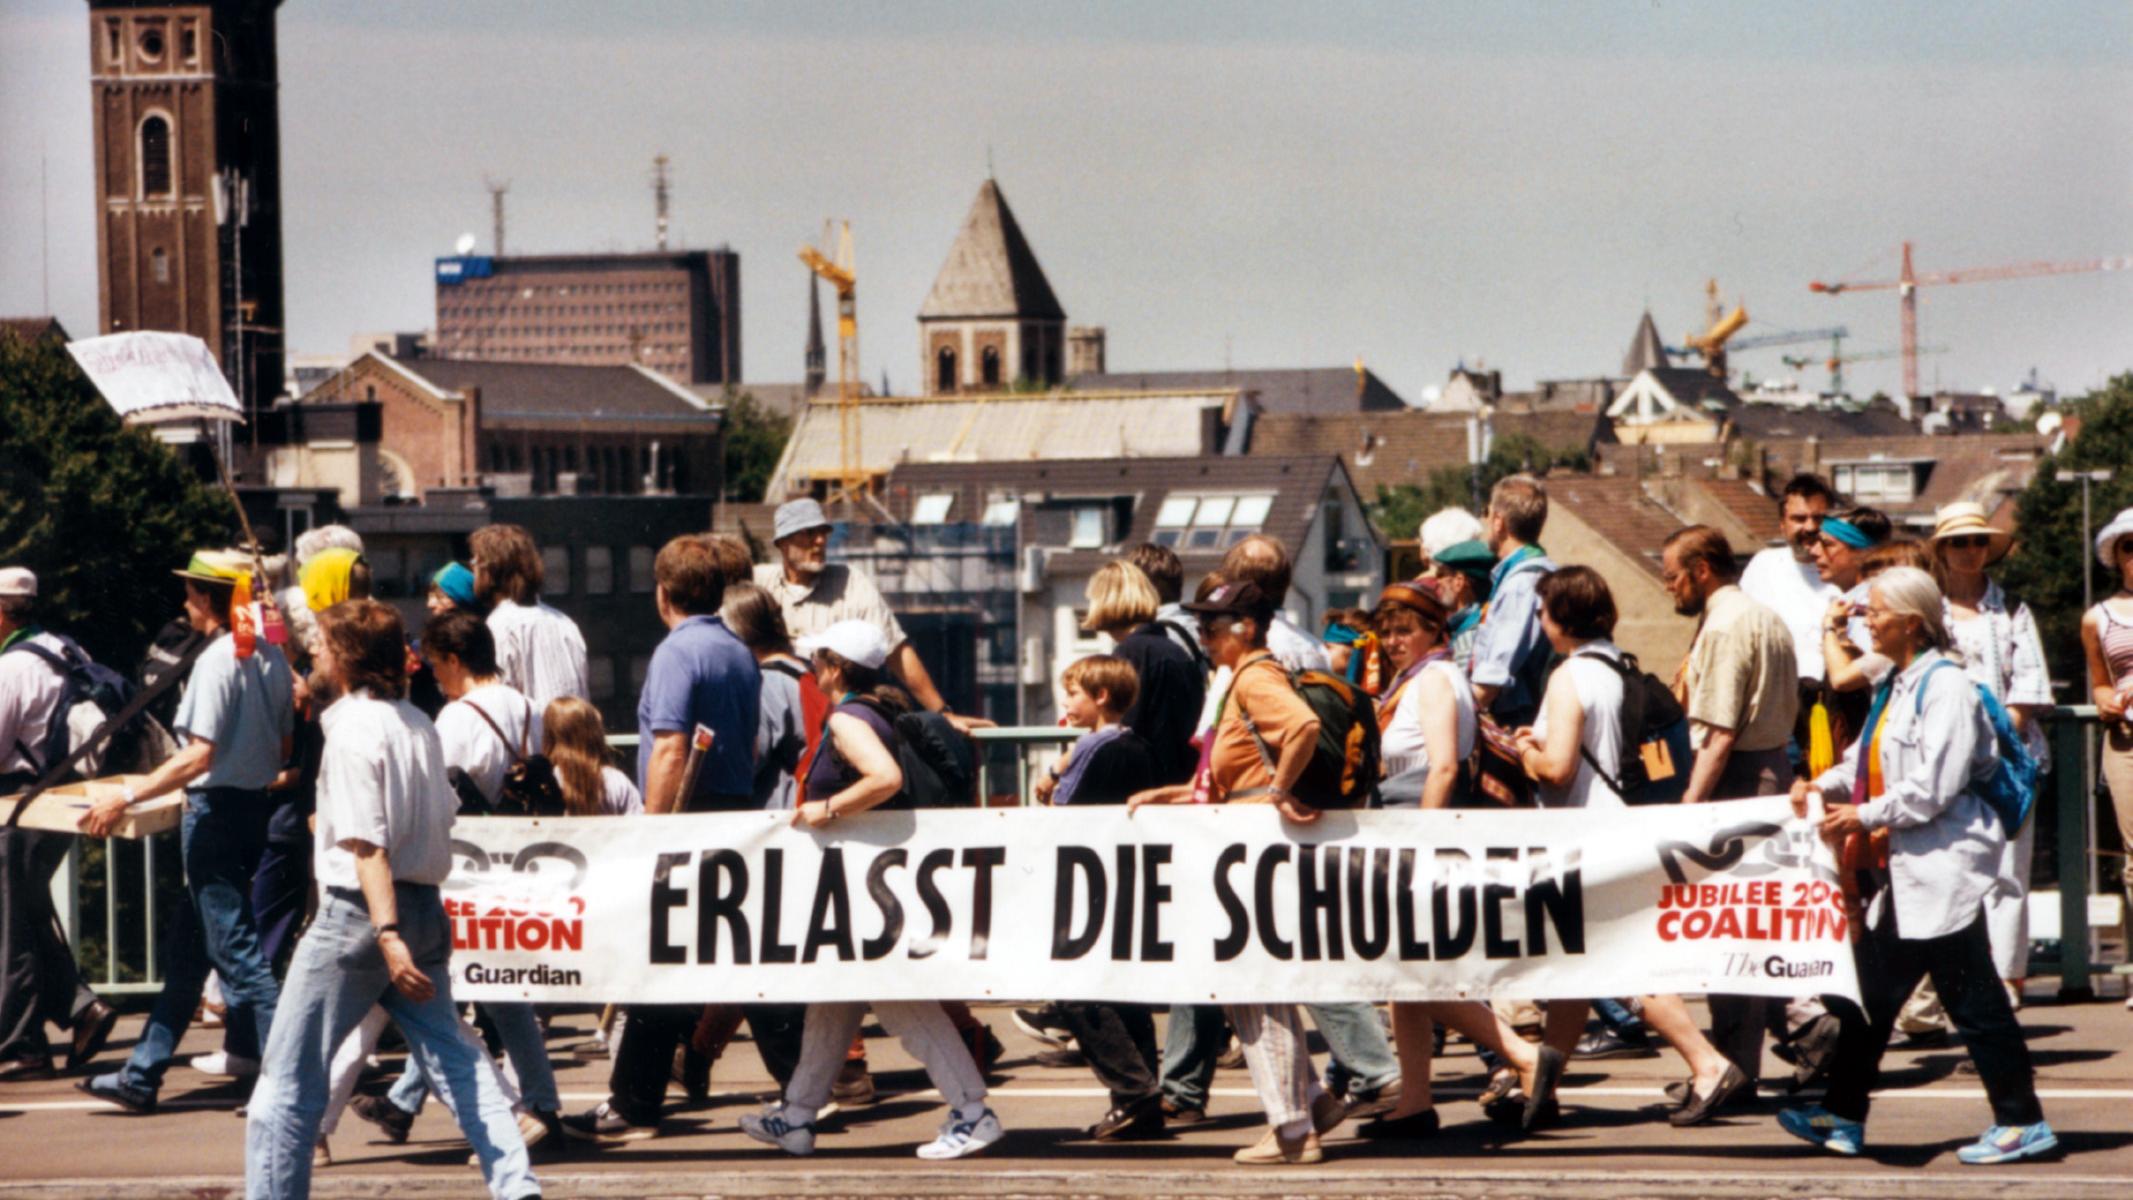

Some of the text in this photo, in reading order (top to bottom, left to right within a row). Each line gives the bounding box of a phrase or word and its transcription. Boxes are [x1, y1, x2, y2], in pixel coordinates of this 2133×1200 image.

[650, 847, 1006, 964] ERLASST
[1051, 843, 1173, 962] DIE
[1213, 842, 1586, 962] SCHULDEN
[1657, 881, 1782, 909] JUBILEE
[464, 962, 582, 985] Guardian
